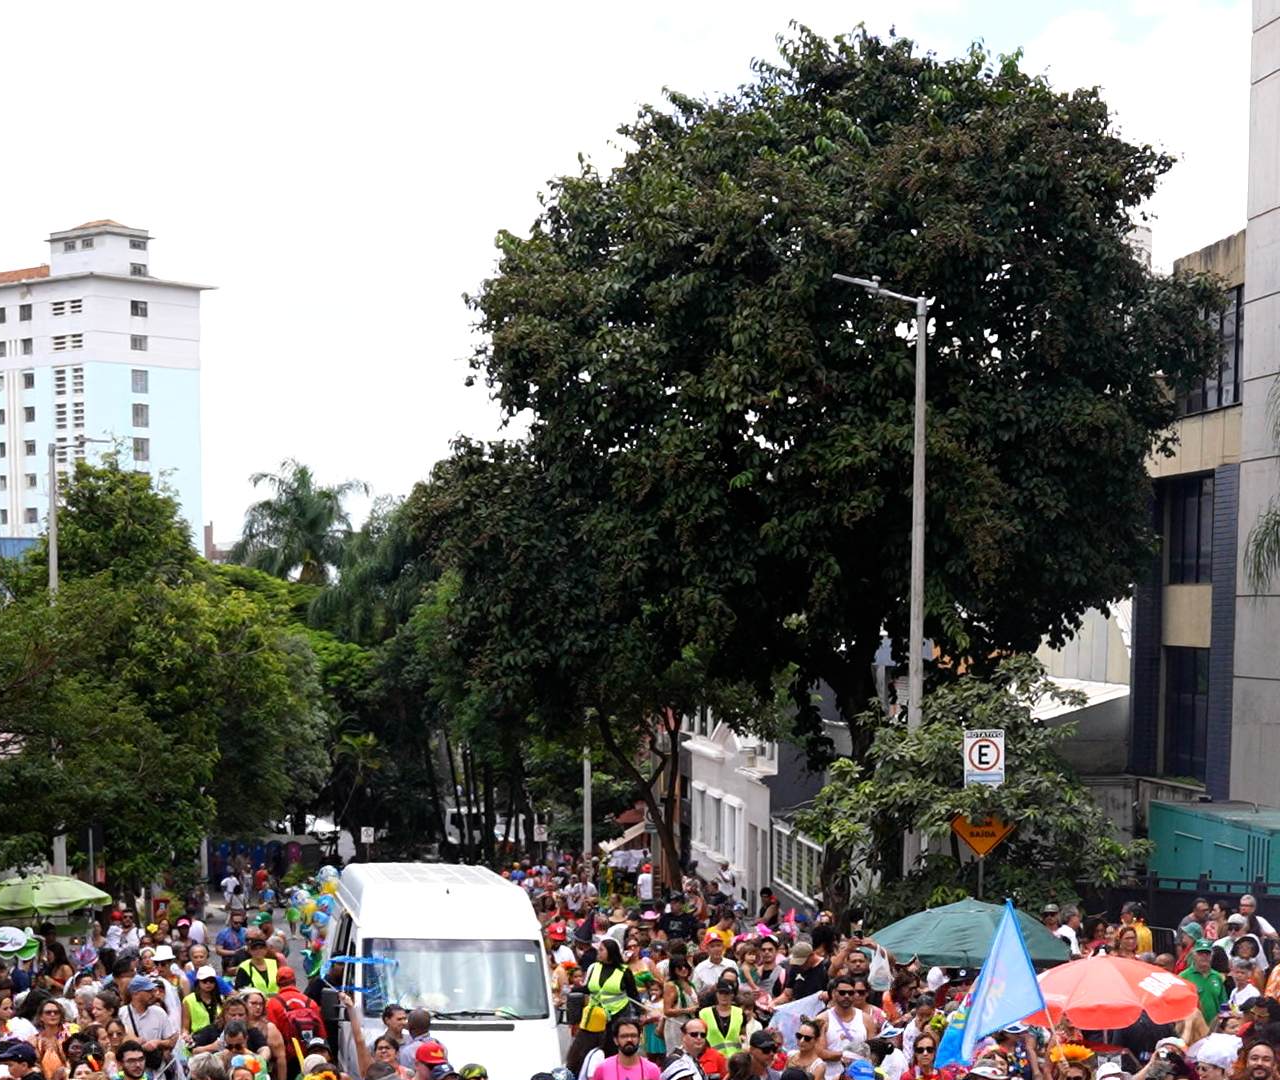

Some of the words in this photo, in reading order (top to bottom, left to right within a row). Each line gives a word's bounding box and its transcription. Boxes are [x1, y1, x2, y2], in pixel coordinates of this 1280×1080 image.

[966, 731, 1003, 739] ROTATIVO
[978, 745, 990, 765] E
[969, 829, 997, 838] SAÍDA
